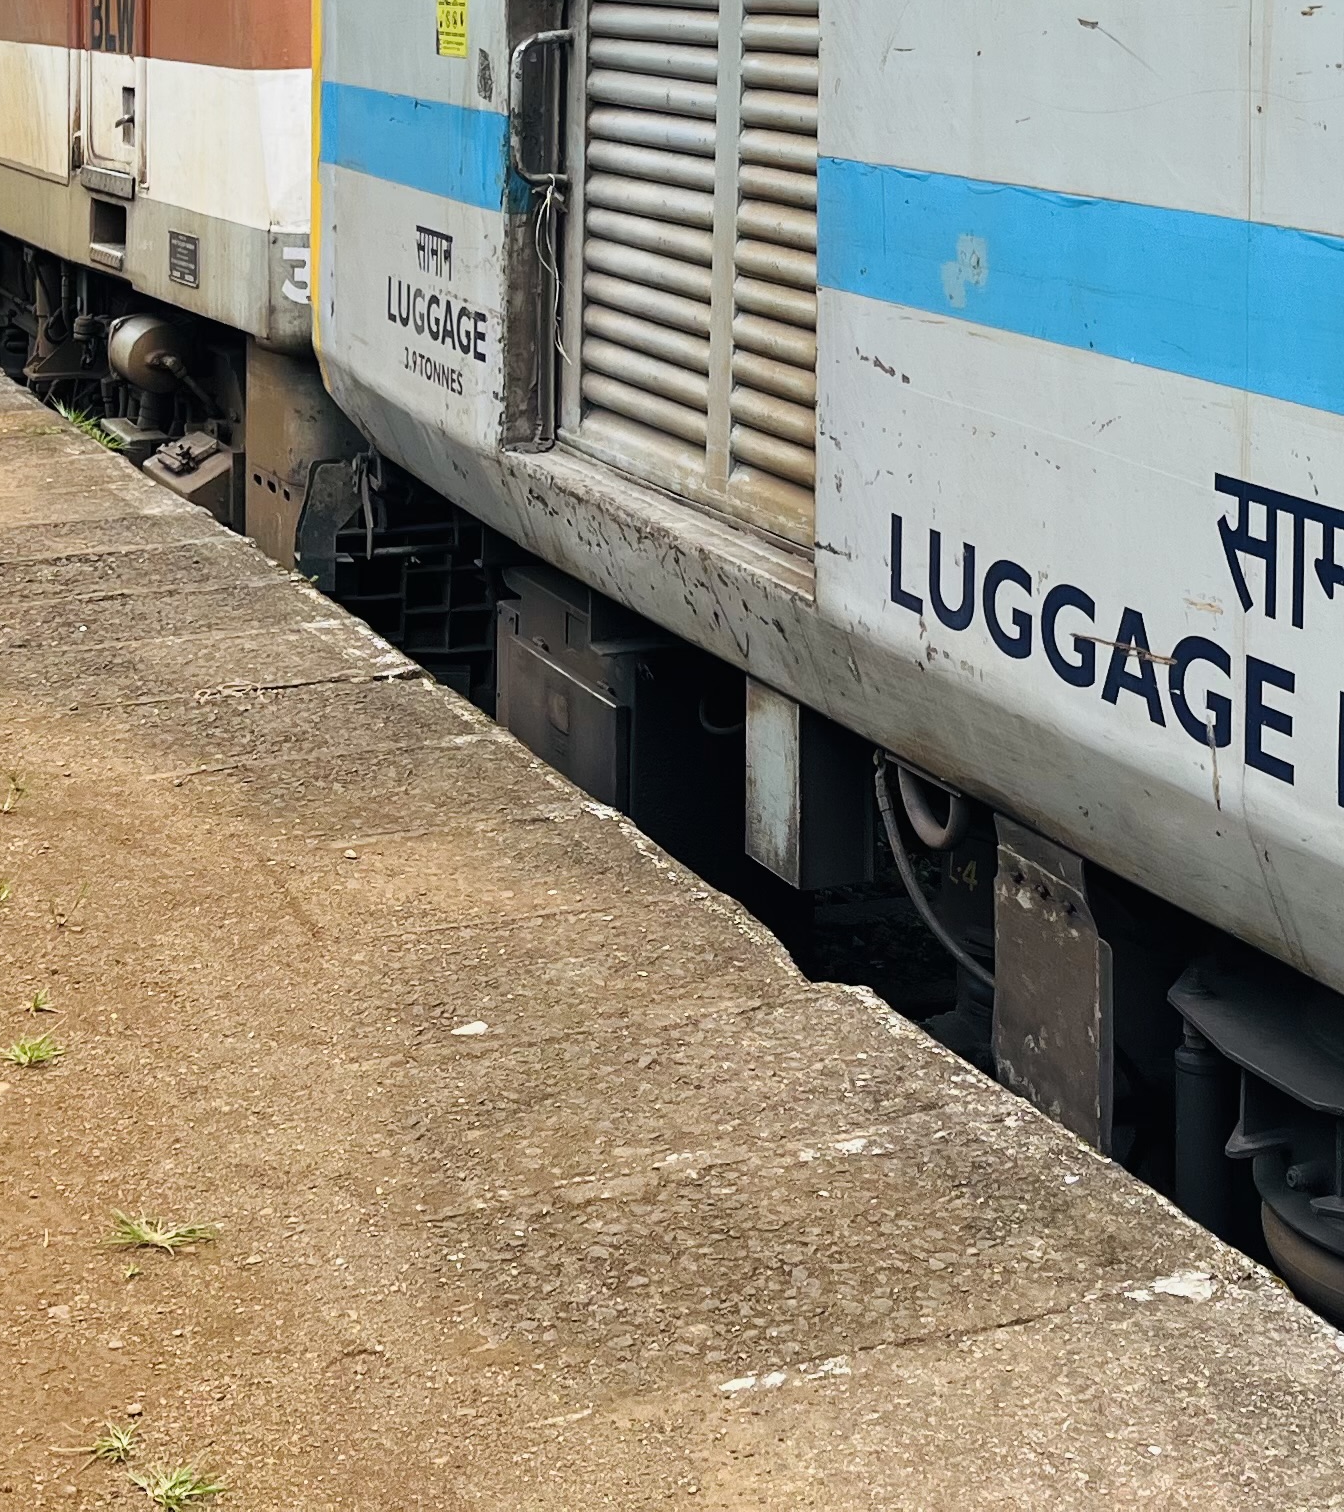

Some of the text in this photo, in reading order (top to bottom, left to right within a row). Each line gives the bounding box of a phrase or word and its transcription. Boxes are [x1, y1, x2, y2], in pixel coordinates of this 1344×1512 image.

[415, 224, 454, 282] सामान
[387, 275, 488, 364] LUGGAGE
[890, 513, 1295, 786] LUGGAGE
